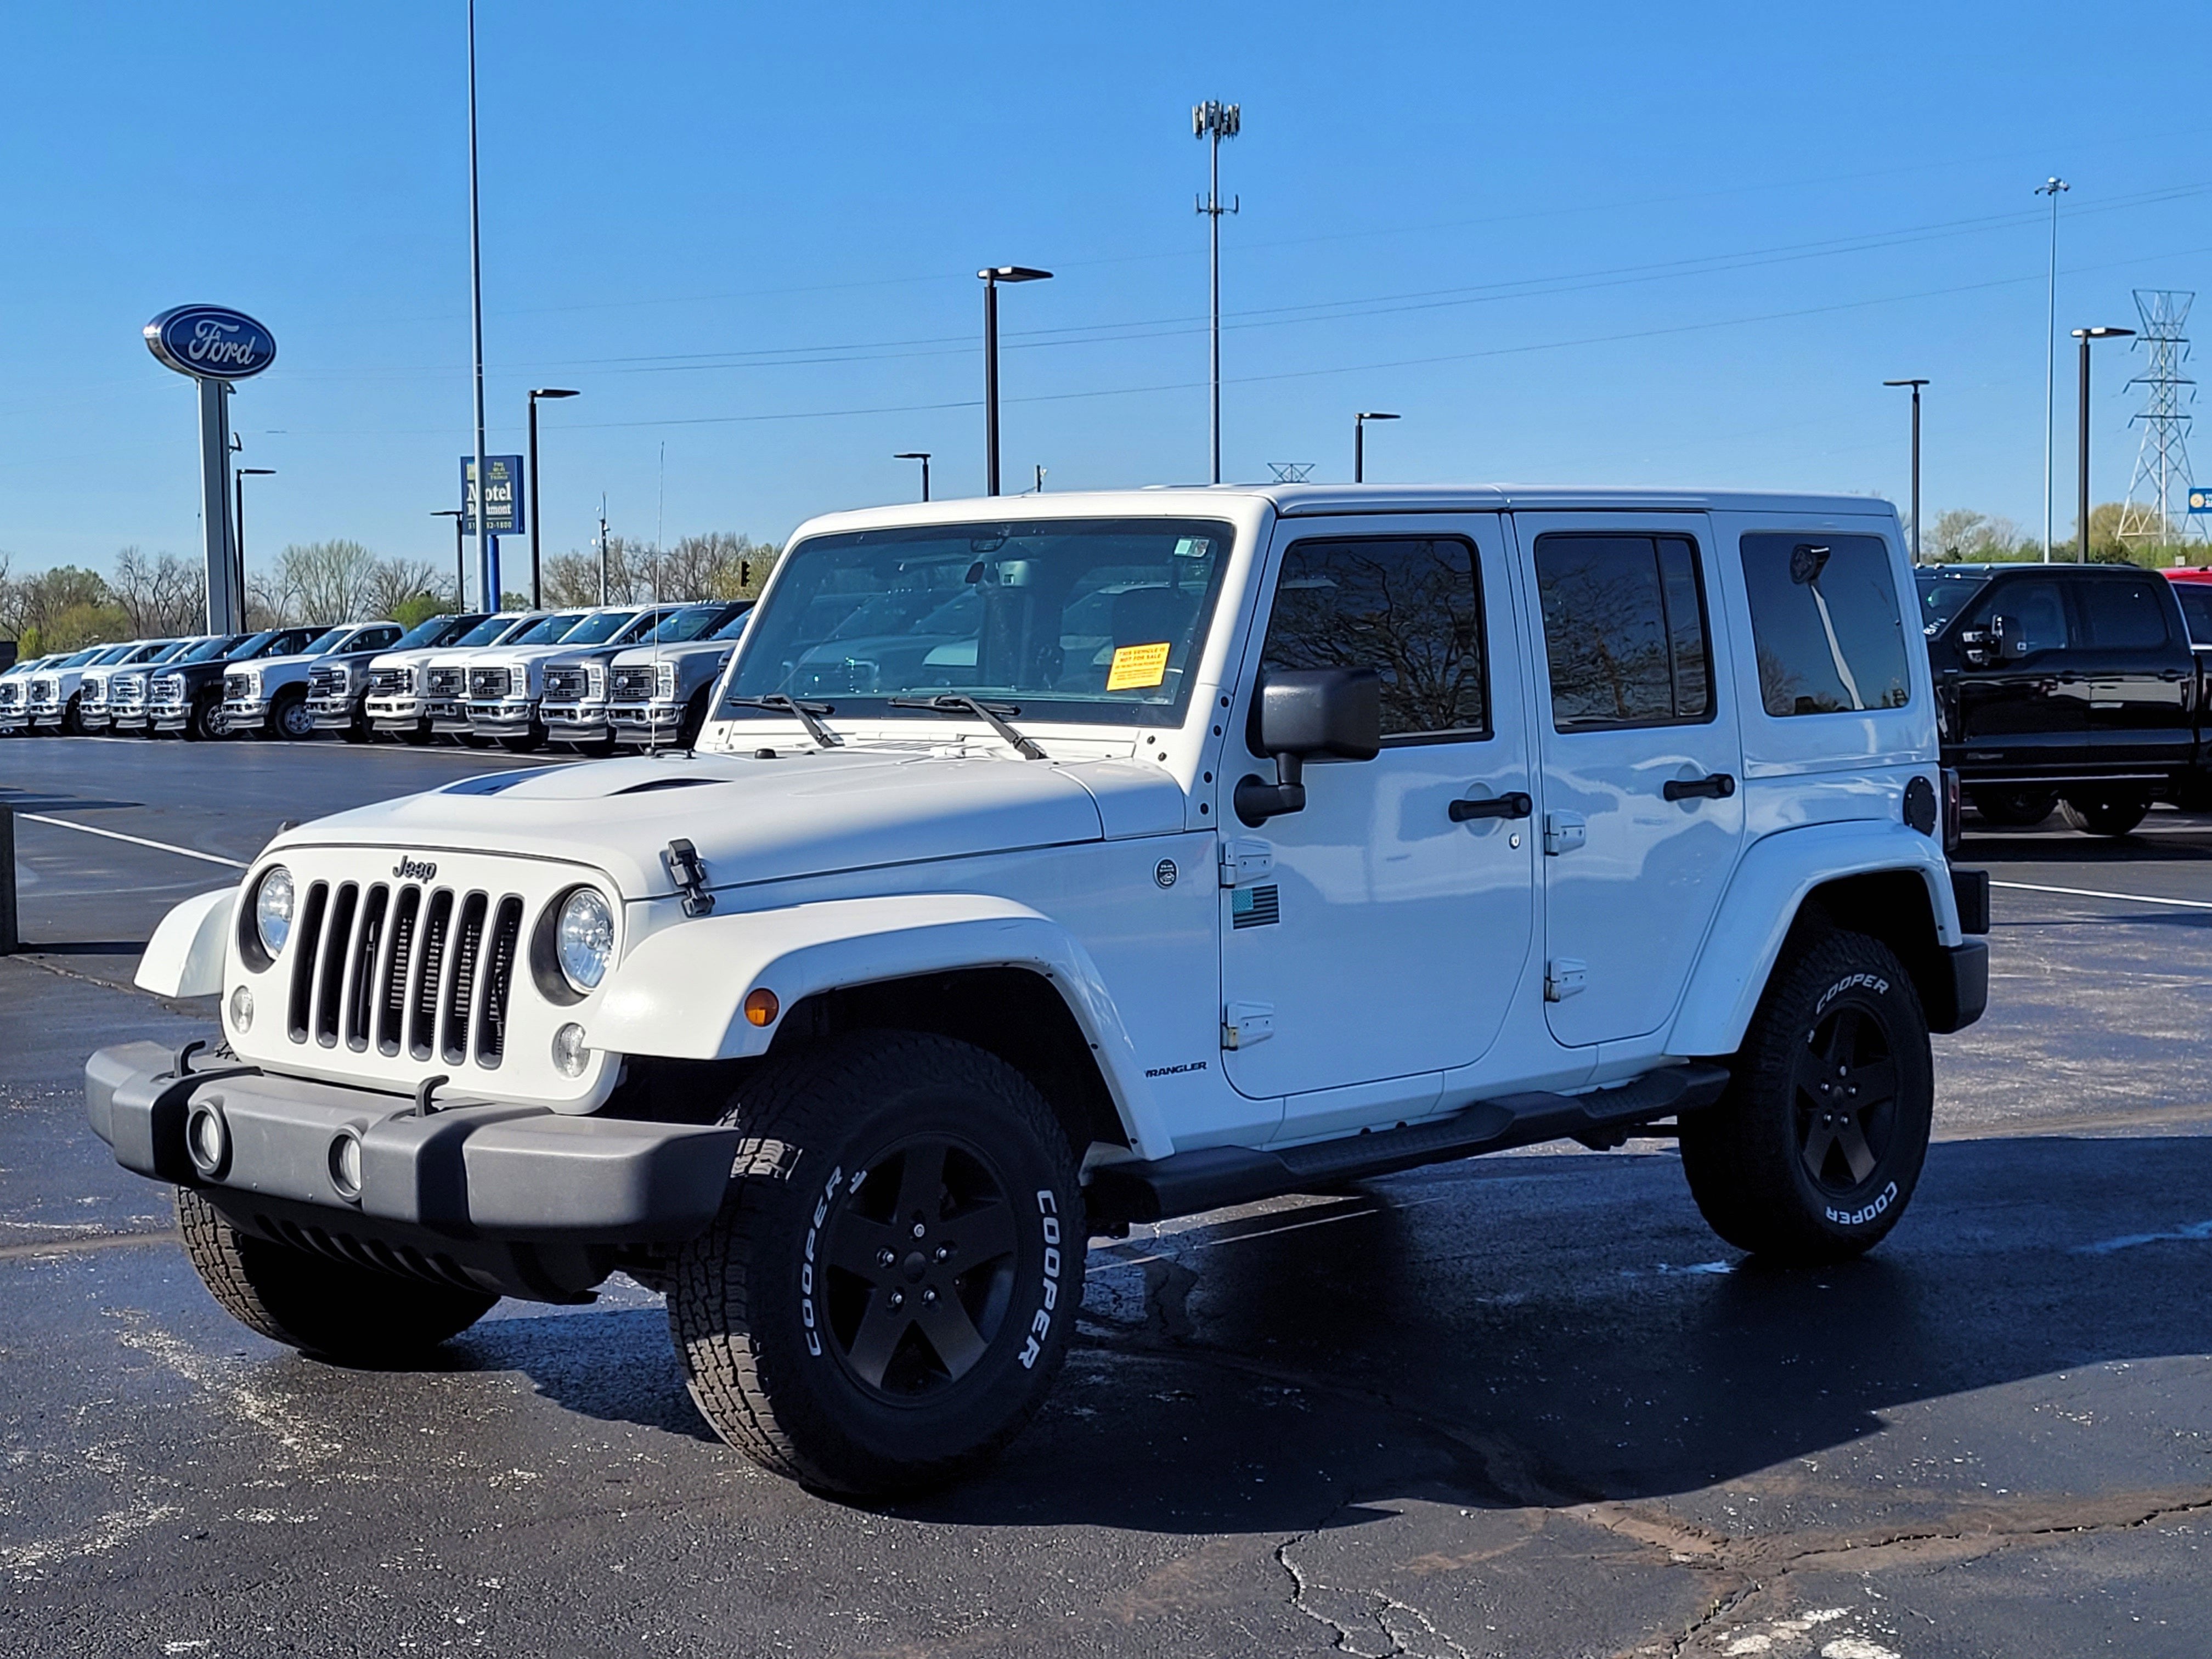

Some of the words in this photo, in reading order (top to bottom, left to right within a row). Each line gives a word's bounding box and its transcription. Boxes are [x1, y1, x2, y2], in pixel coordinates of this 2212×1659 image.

[189, 319, 256, 365] Ford
[467, 501, 511, 516] Bhmont
[392, 855, 437, 884] Jeep
[1816, 973, 1889, 1015] COOPER
[1826, 1181, 1898, 1224] COOPER
[802, 1165, 843, 1356] COOPER
[1018, 1189, 1060, 1369] COOPER
